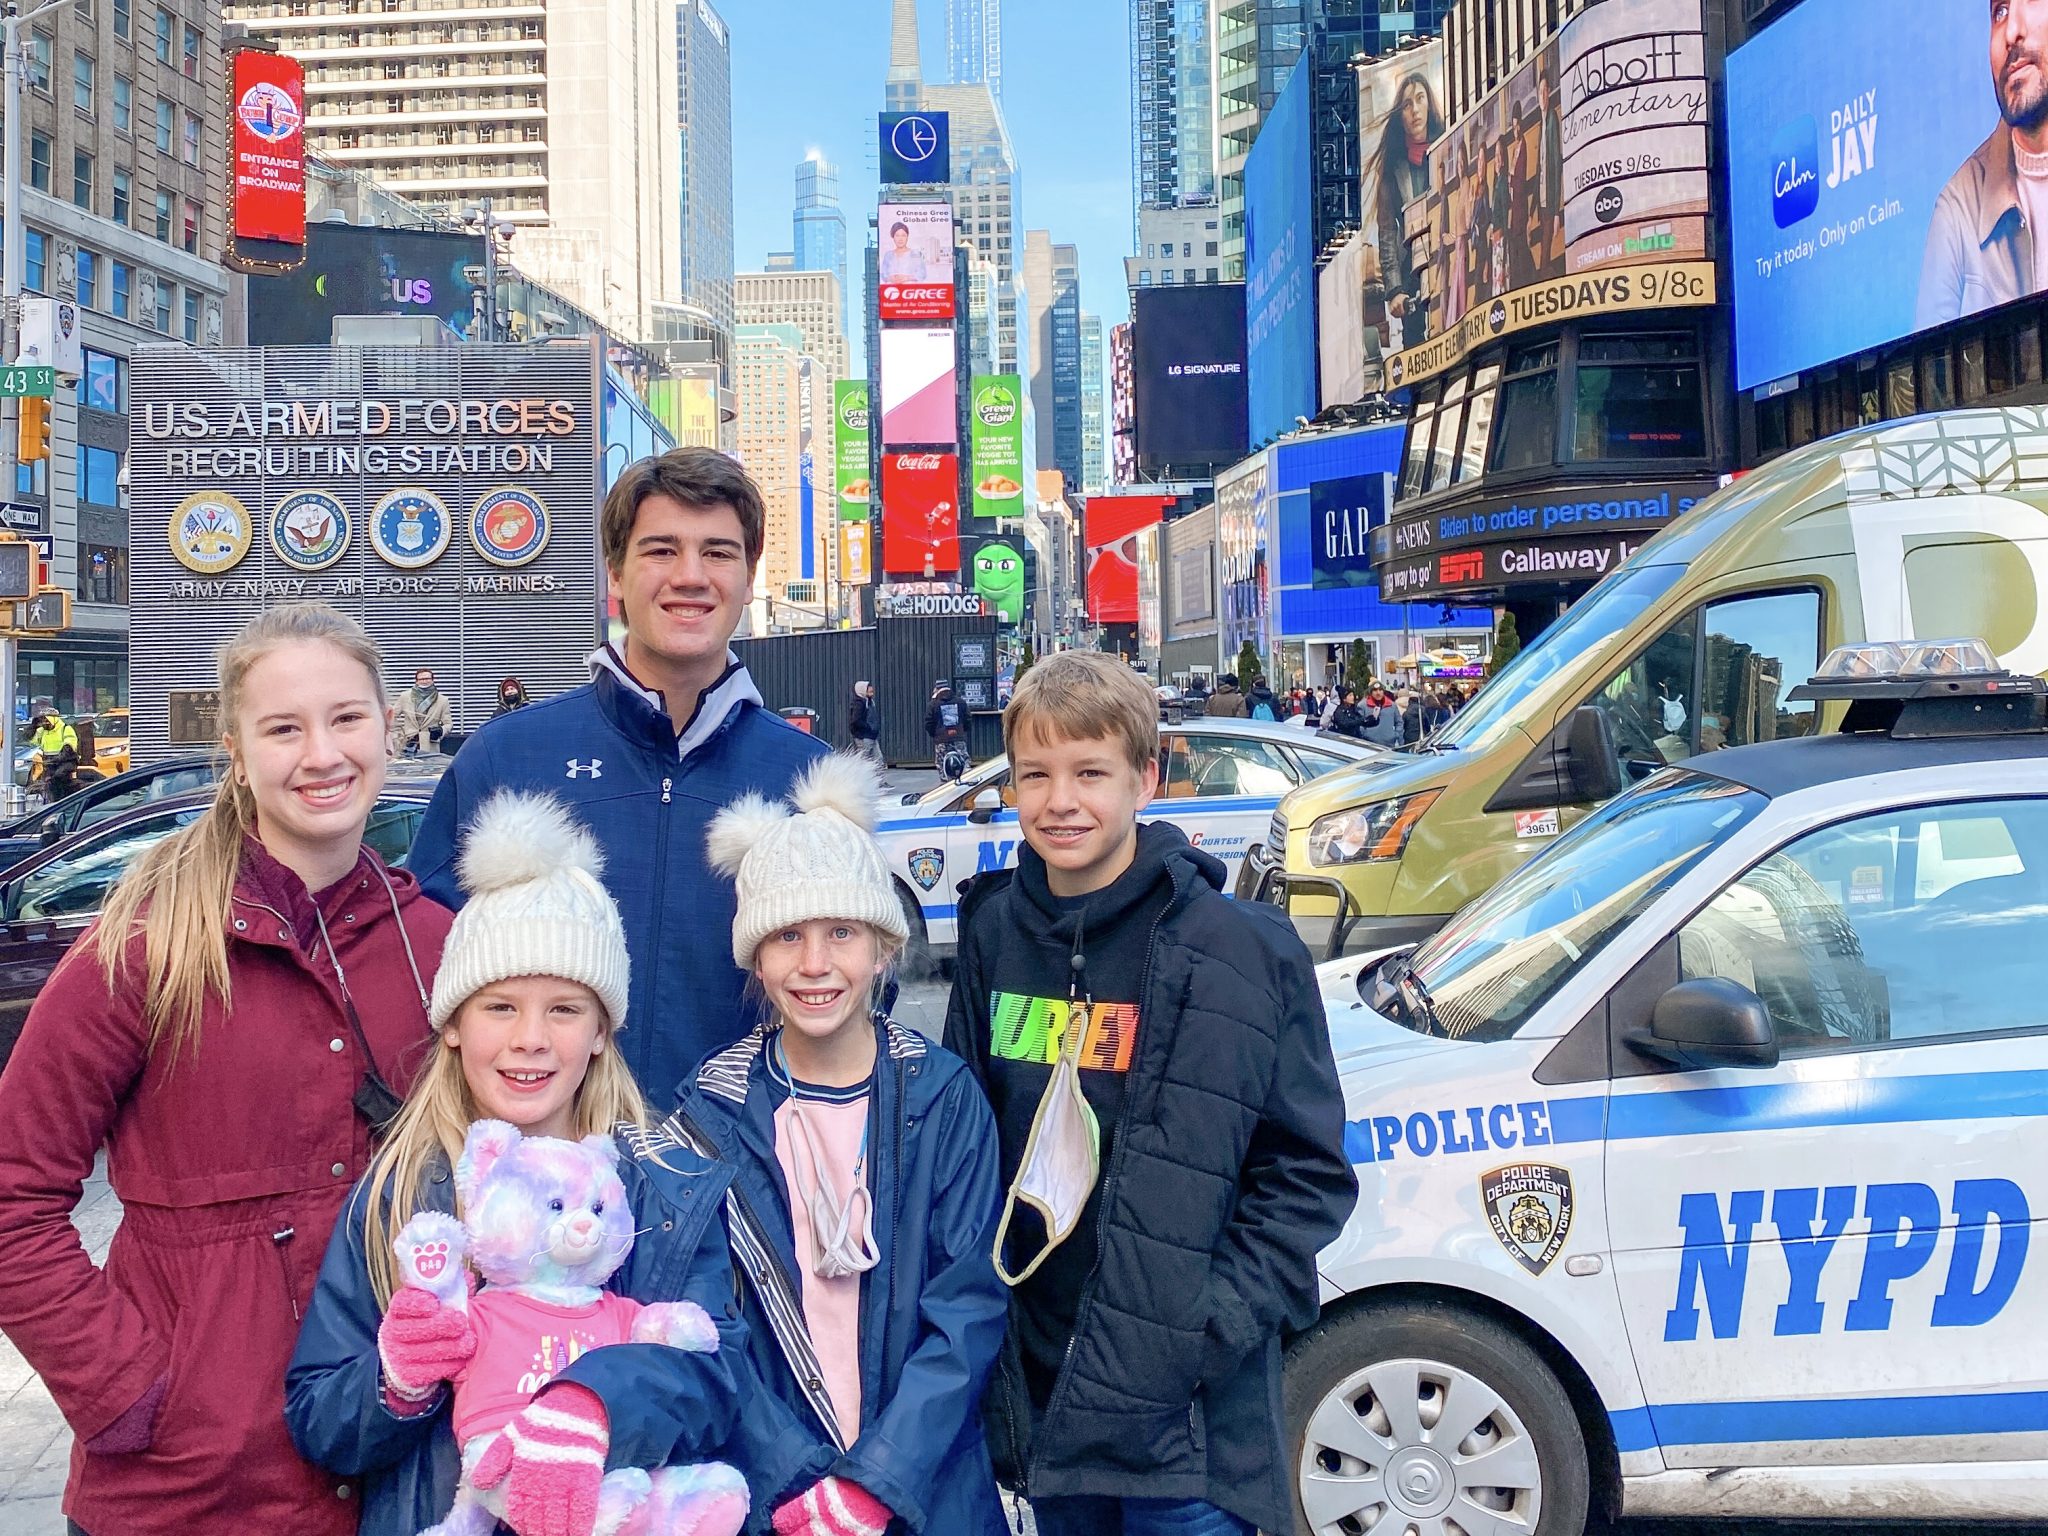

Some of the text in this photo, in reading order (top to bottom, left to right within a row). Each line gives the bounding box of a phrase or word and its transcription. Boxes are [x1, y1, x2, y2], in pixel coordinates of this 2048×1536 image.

[1571, 34, 1681, 110] Abbott
[1562, 87, 1707, 144] Elementary
[1831, 87, 1876, 134] DAILY
[240, 152, 299, 170] ENTRANCE
[1826, 114, 1878, 189] JAY
[239, 176, 301, 193] BROADWAY
[261, 167, 278, 178] ON
[1574, 154, 1661, 191] TUESDAYS 9/8c
[1775, 156, 1816, 198] Calm
[1595, 196, 1622, 213] abc
[1755, 198, 1904, 278] Try it today. Only on Calm.
[1577, 247, 1605, 268] STREAM
[1607, 243, 1622, 256] ON
[902, 288, 948, 300] GREE
[1511, 270, 1704, 323] TUESDAYS 9/8c
[1168, 363, 1241, 375] LG SIGNATURE
[1407, 342, 1443, 378] ABBOTT
[4, 370, 50, 393] 43 St
[145, 399, 575, 438] U.S. ARMED FORCES
[849, 417, 868, 427] Gia
[981, 405, 1013, 413] Green
[984, 413, 1014, 422] Giant
[166, 444, 552, 477] RECRUITING STATION
[3, 510, 36, 523] ONE WAY
[477, 493, 510, 527] DEPARTMENT
[530, 502, 543, 521] NAVY
[1402, 520, 1431, 549] NEWS
[1440, 516, 1469, 539] Biden
[1472, 513, 1486, 533] to
[1490, 505, 1537, 530] order
[1543, 492, 1670, 529] personal
[1324, 507, 1370, 559] GAP
[1222, 549, 1256, 585] OLD NAVY
[1394, 570, 1408, 590] way
[1409, 565, 1417, 585] to
[1439, 550, 1484, 583] ESPN
[1501, 546, 1610, 574] Callaway
[167, 575, 554, 598] ARMY NAVY AIR FORC MARINES
[893, 605, 914, 615] best
[914, 595, 979, 614] HOTDOGS
[1526, 823, 1557, 834] 39617
[1373, 1101, 1551, 1161] POLICE
[1486, 1178, 1569, 1203] DEPARTMENT
[1501, 1166, 1551, 1182] POLICE
[1491, 1214, 1526, 1260] CITY OF
[1541, 1204, 1571, 1263] NEW YORK
[1664, 1178, 2030, 1341] NYPD
